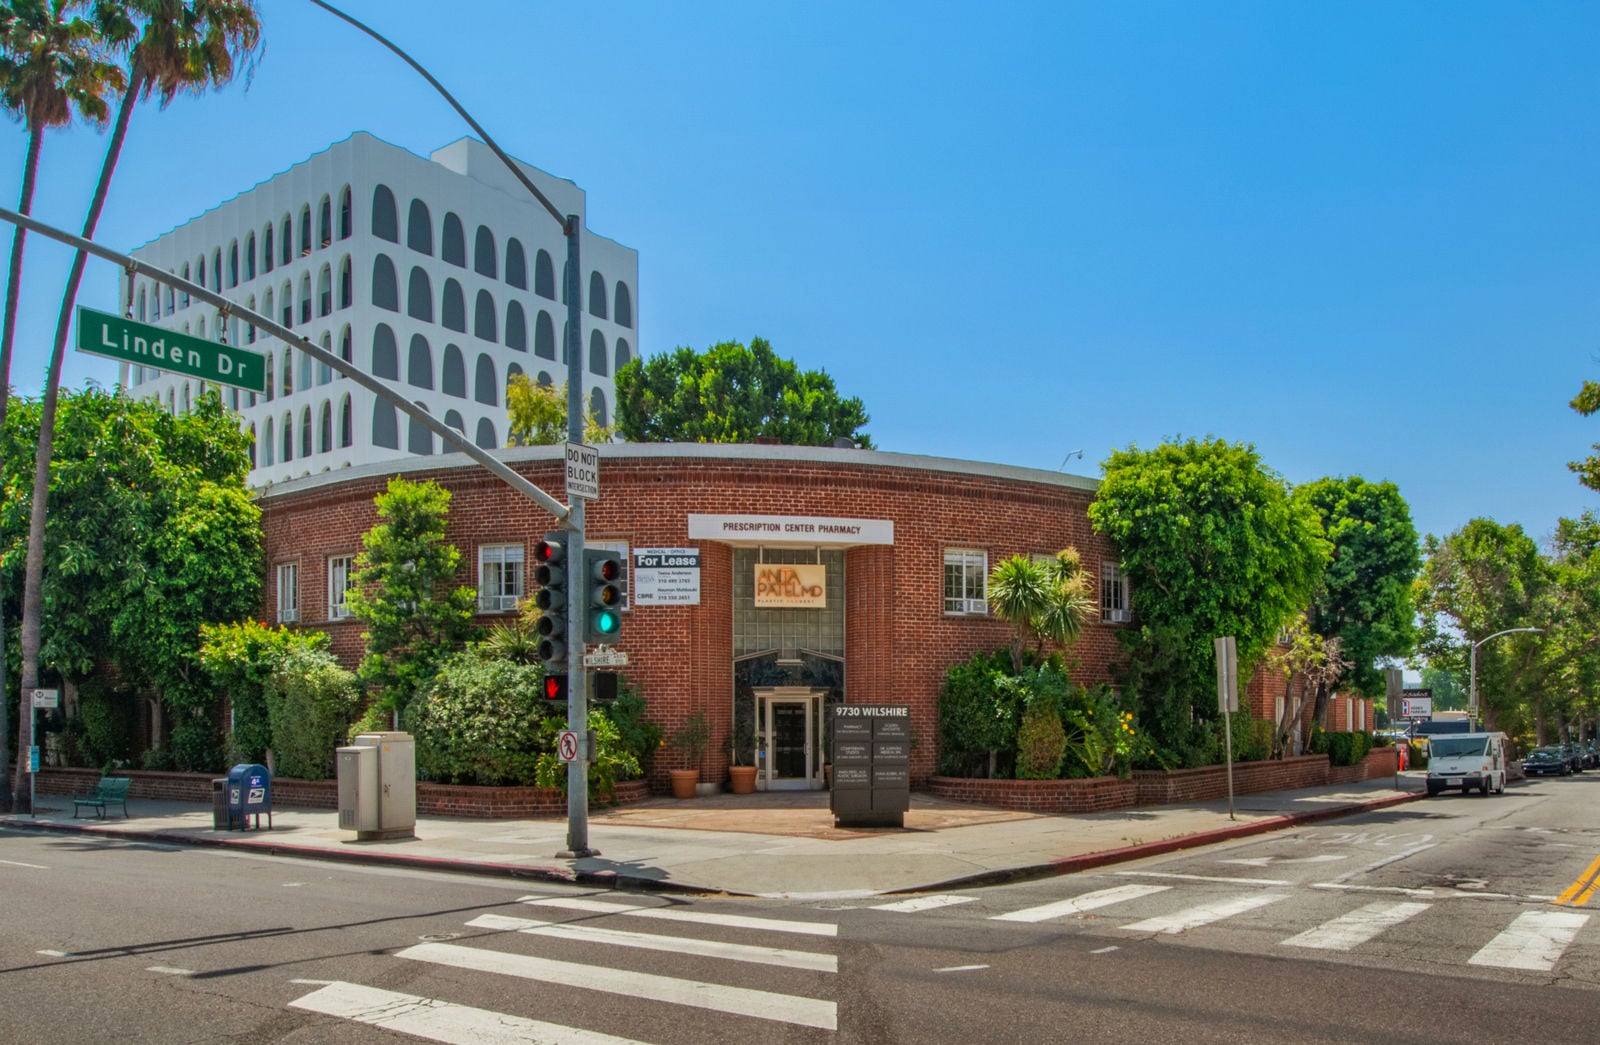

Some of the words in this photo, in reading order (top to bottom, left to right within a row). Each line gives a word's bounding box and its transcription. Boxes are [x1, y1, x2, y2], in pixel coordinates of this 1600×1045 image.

[102, 324, 201, 368] Linden
[218, 353, 247, 378] Dr
[568, 449, 579, 462] DO
[581, 452, 596, 466] NOT
[568, 466, 597, 483] BLOCK
[723, 522, 780, 532] PRESCRIPTION
[785, 523, 815, 533] CENTER
[818, 525, 861, 535] PHARMACY
[638, 555, 659, 566] For
[661, 555, 697, 566] Lease
[758, 568, 802, 585] ANITA
[585, 655, 610, 665] WILSHIRE
[836, 706, 860, 716] 9730
[862, 707, 908, 717] WILSHIRE
